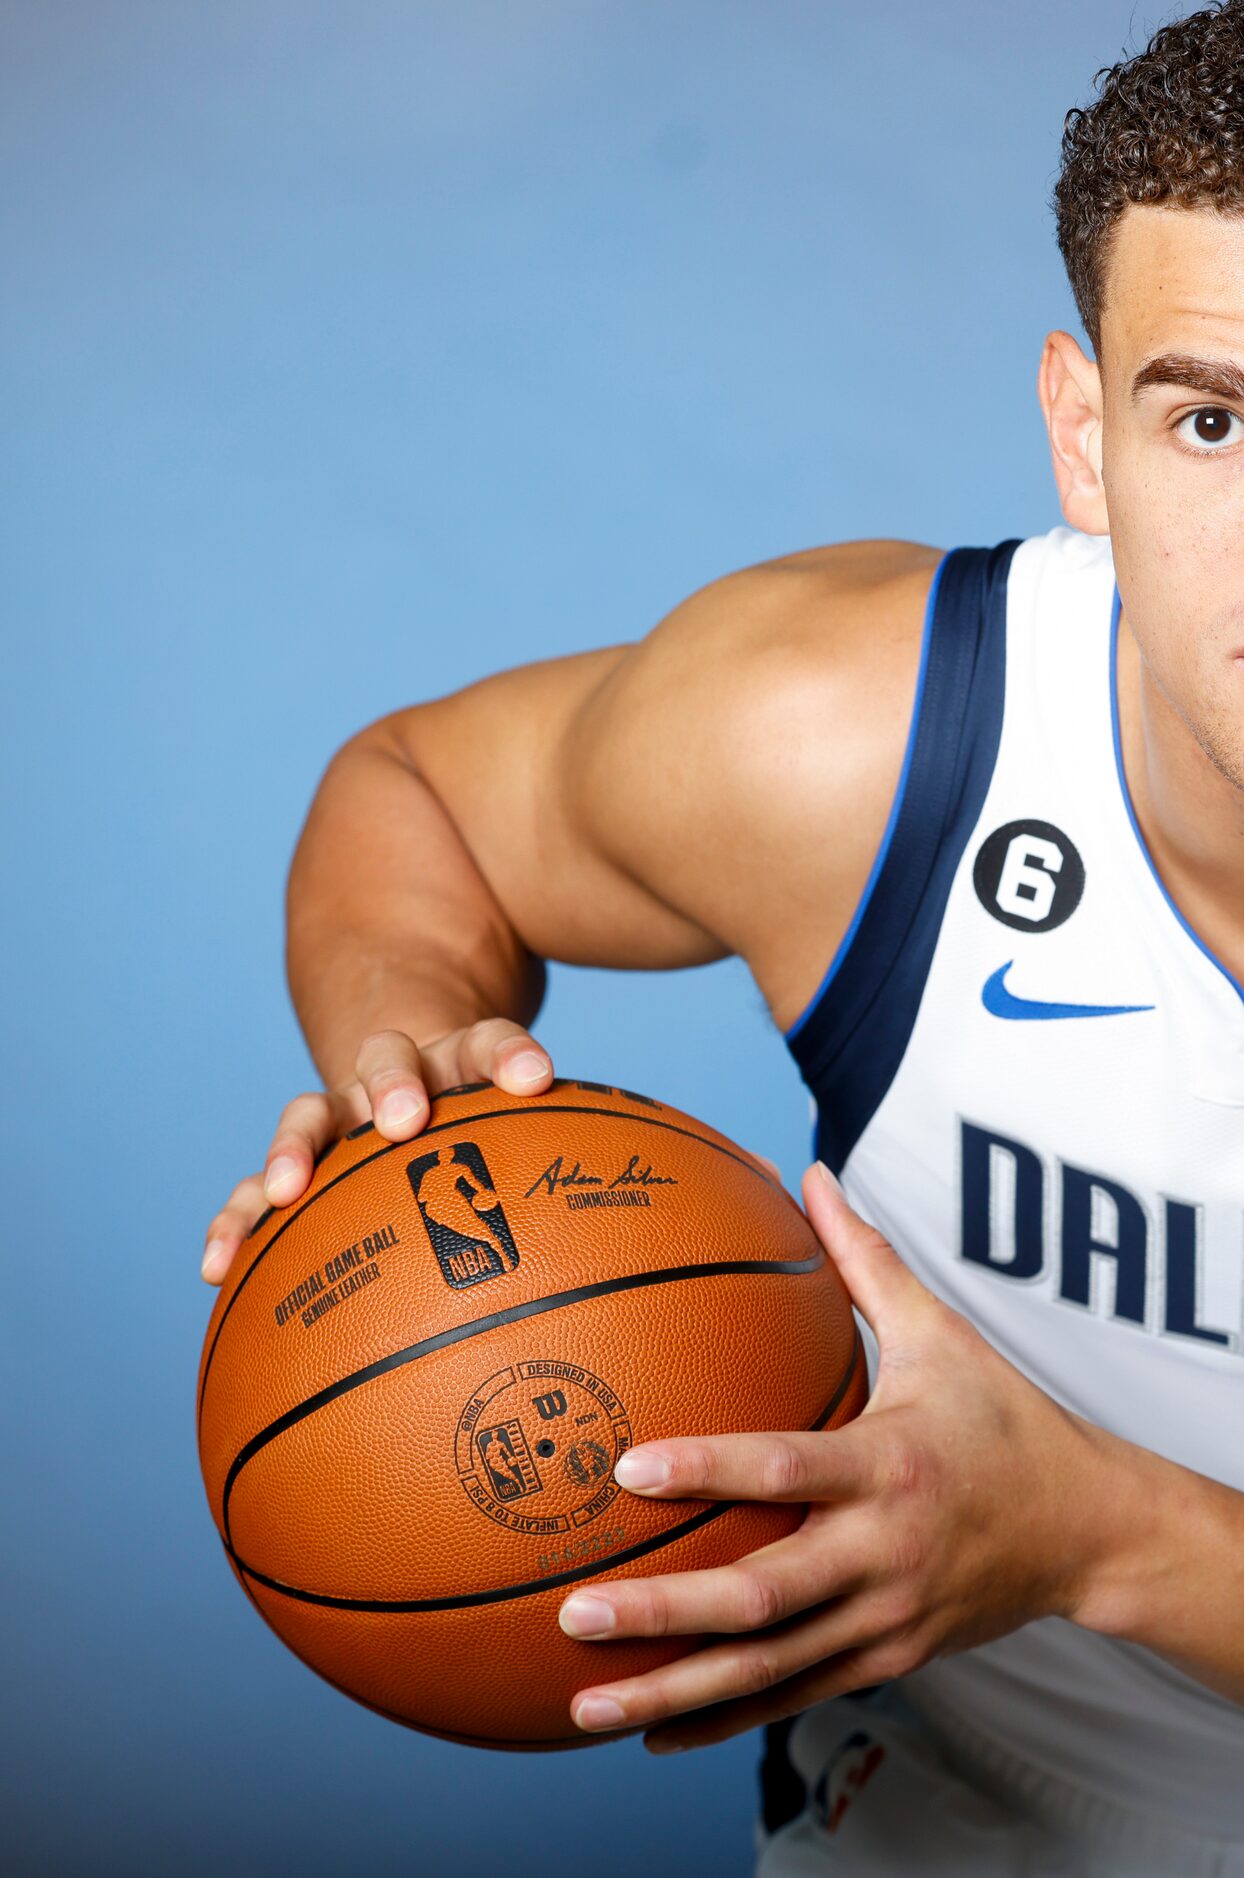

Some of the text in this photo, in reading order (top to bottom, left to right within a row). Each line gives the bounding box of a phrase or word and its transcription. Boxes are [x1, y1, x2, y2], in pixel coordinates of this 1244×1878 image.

[996, 833, 1063, 922] 6
[566, 1190, 652, 1211] COMMISSIONER
[274, 1224, 400, 1327] OFFICIAL GAME BALL
[448, 1247, 492, 1282] NBA
[301, 1262, 380, 1328] GENUINE LEATHER
[527, 1364, 617, 1412] DESIGNED IN USA
[461, 1398, 484, 1432] @NBA
[575, 1411, 599, 1427] NDN
[500, 1482, 516, 1496] NBA
[586, 1486, 615, 1515] CHINA
[469, 1486, 559, 1531] INFLATE TO 8 PSI
